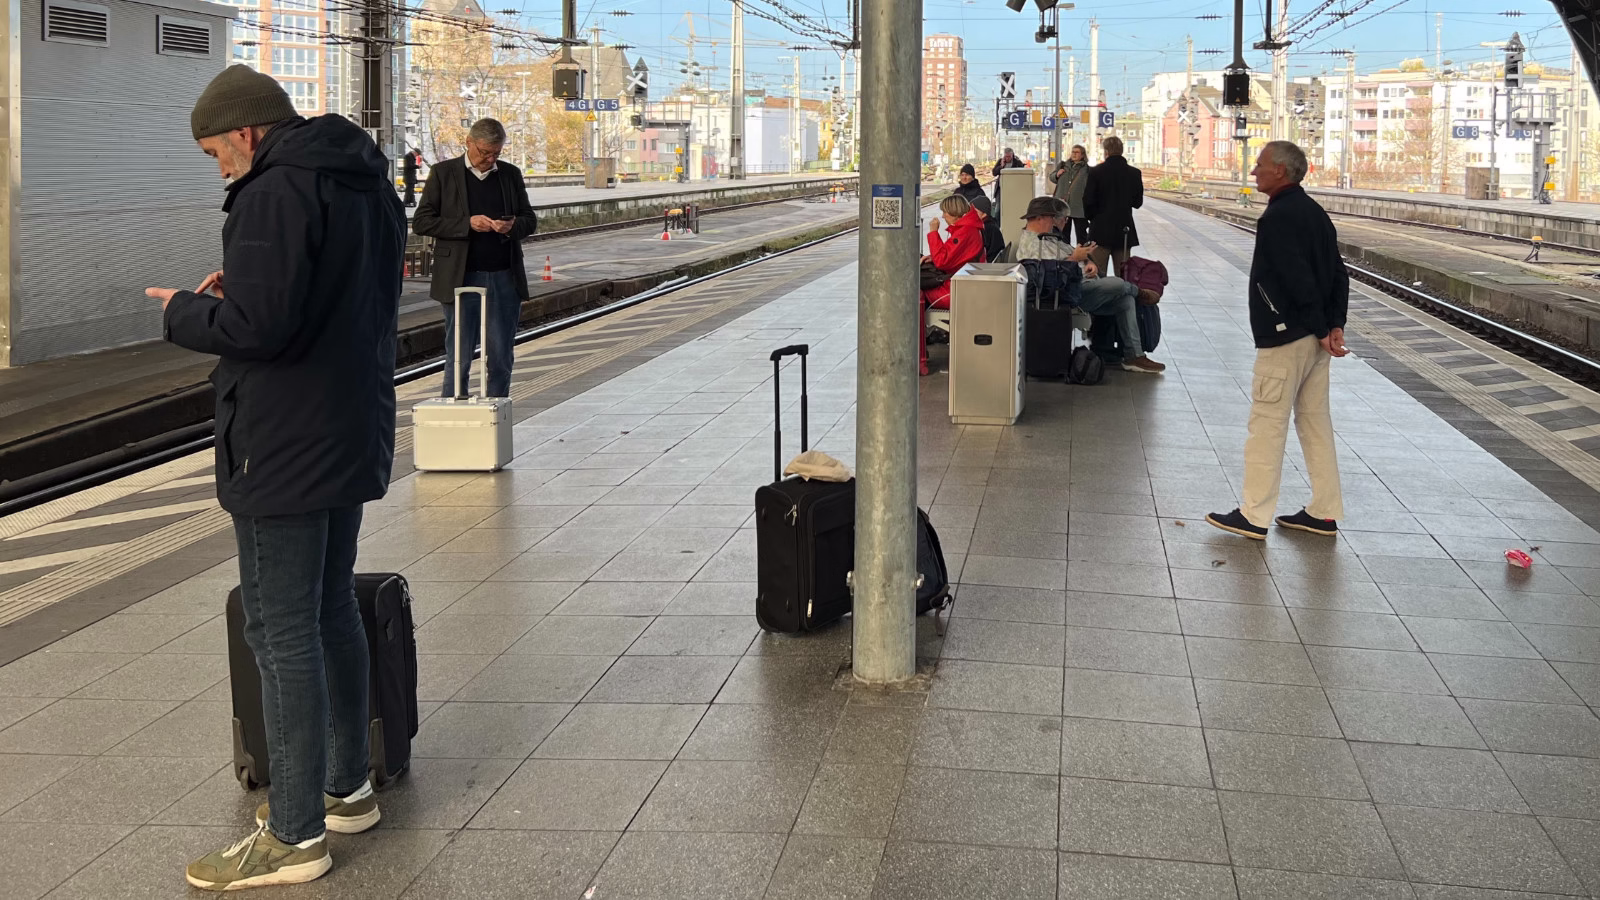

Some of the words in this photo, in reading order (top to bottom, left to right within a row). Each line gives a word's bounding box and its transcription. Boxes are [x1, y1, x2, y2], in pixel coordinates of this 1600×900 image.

[569, 101, 575, 109] 4
[578, 100, 586, 109] G
[597, 100, 605, 109] G
[611, 100, 618, 109] 5
[1009, 113, 1020, 125] G
[1044, 116, 1051, 127] 6
[1102, 113, 1113, 125] G
[1456, 127, 1465, 136] G
[1471, 127, 1478, 136] 8
